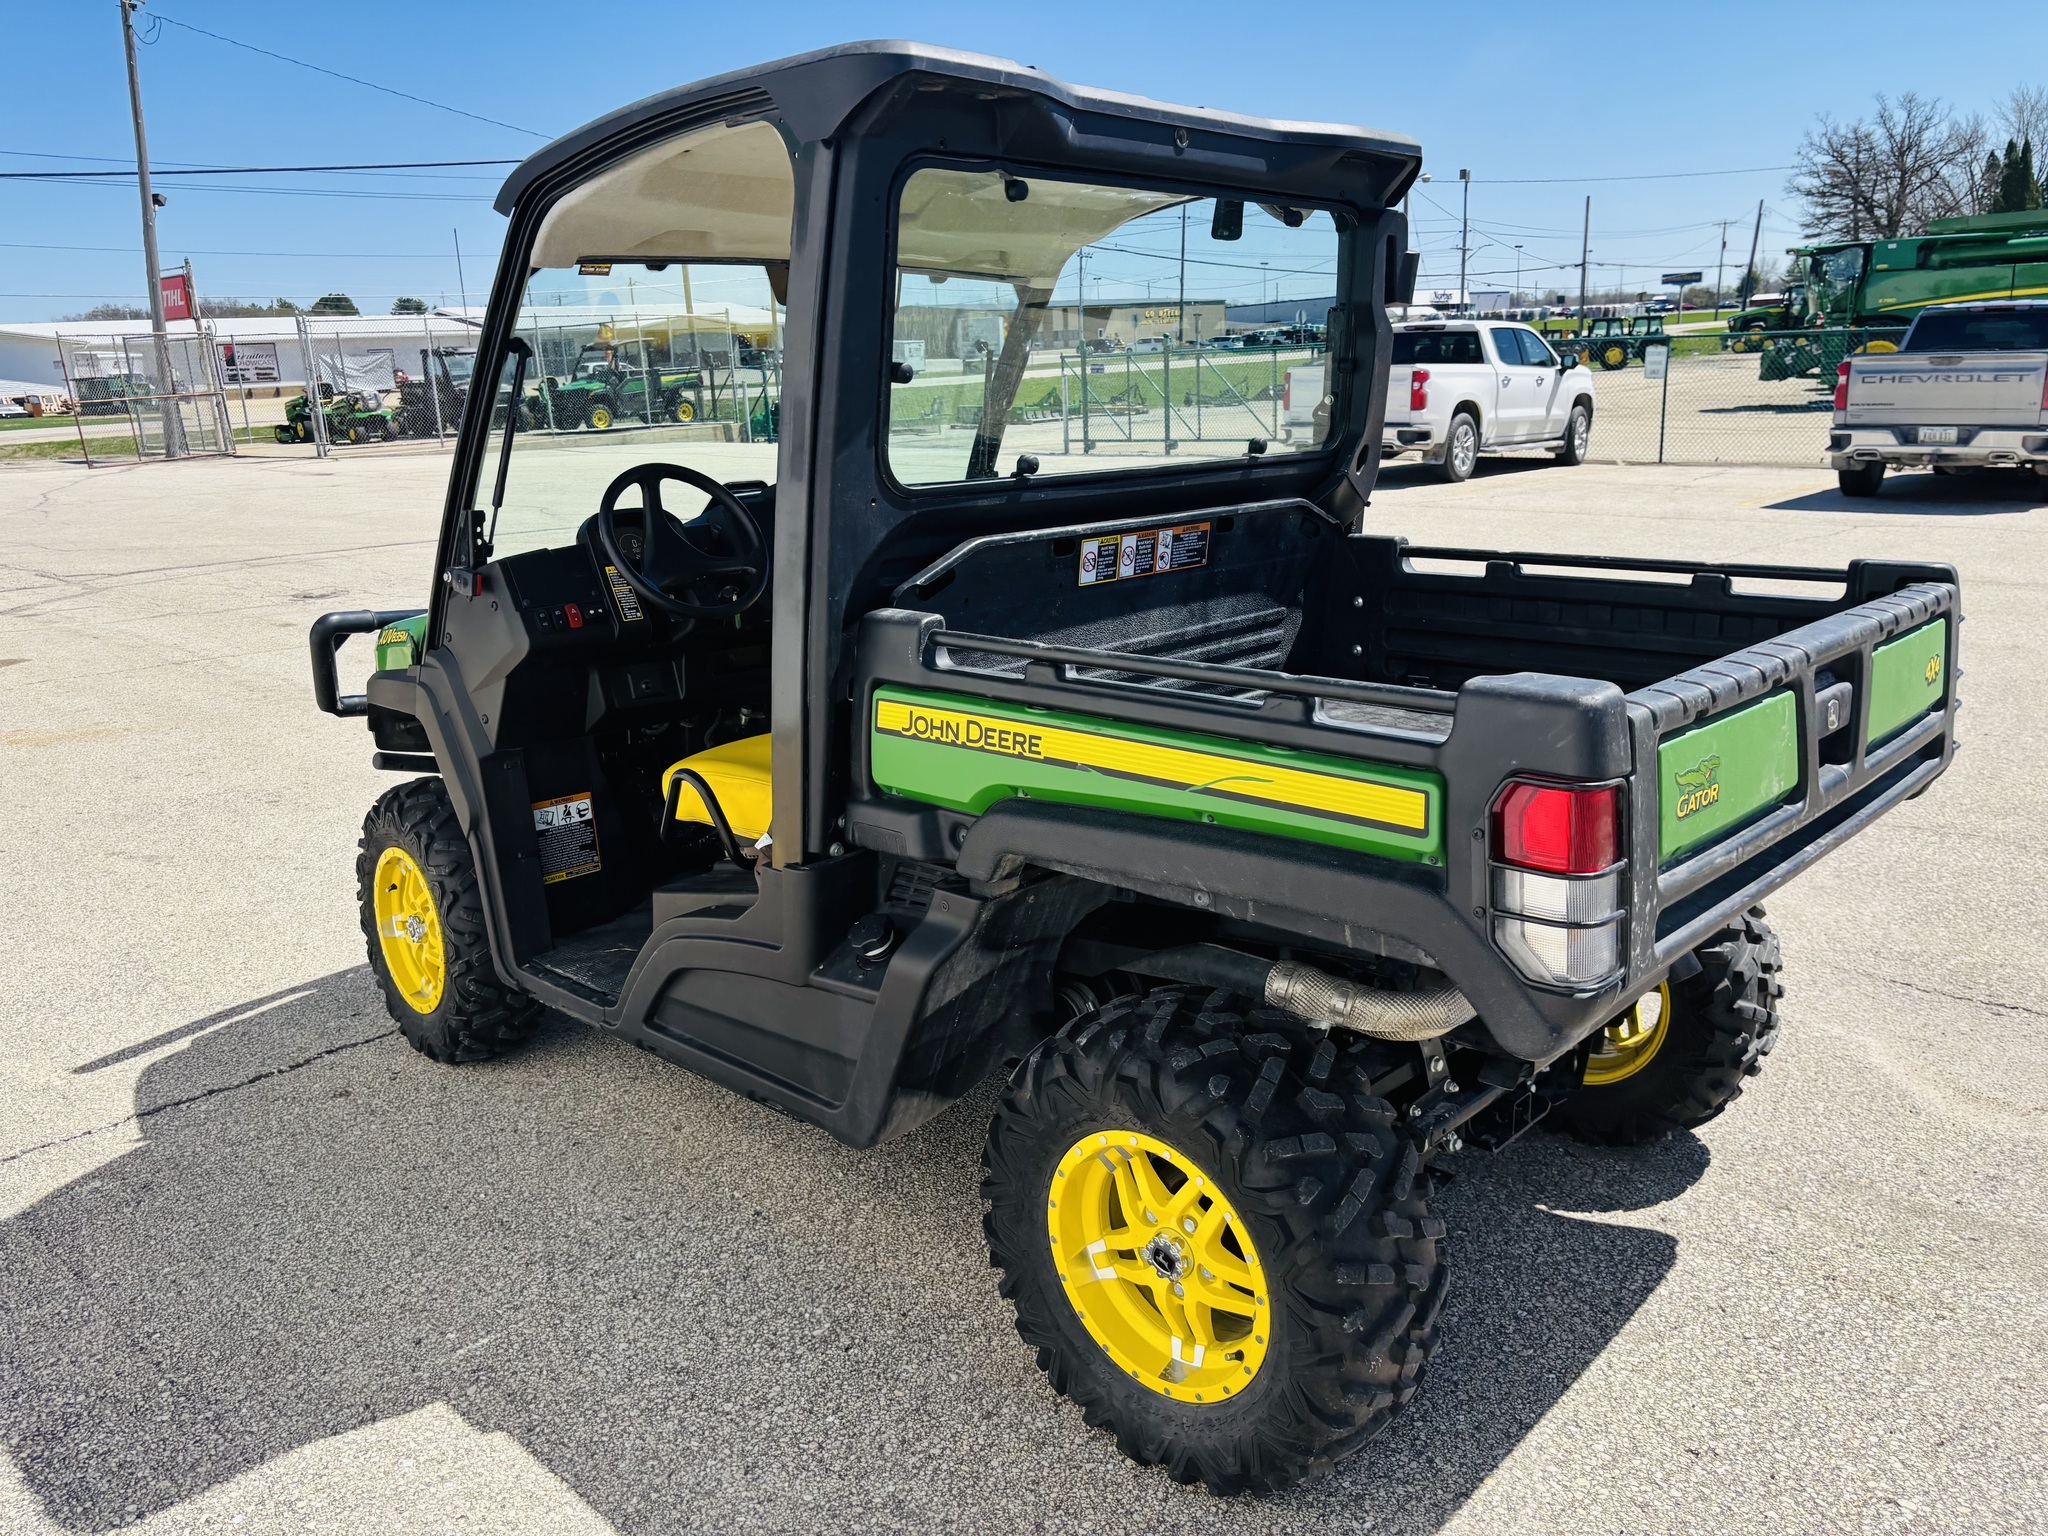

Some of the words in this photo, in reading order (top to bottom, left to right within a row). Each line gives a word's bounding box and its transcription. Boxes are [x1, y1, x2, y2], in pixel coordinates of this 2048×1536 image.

[162, 288, 185, 307] TIHL
[1861, 374, 2031, 384] CHEVROLET
[1925, 654, 1940, 684] 4X4
[901, 710, 960, 742] JOHN
[966, 719, 1043, 756] DEERE
[1676, 783, 1720, 818] GATOR
